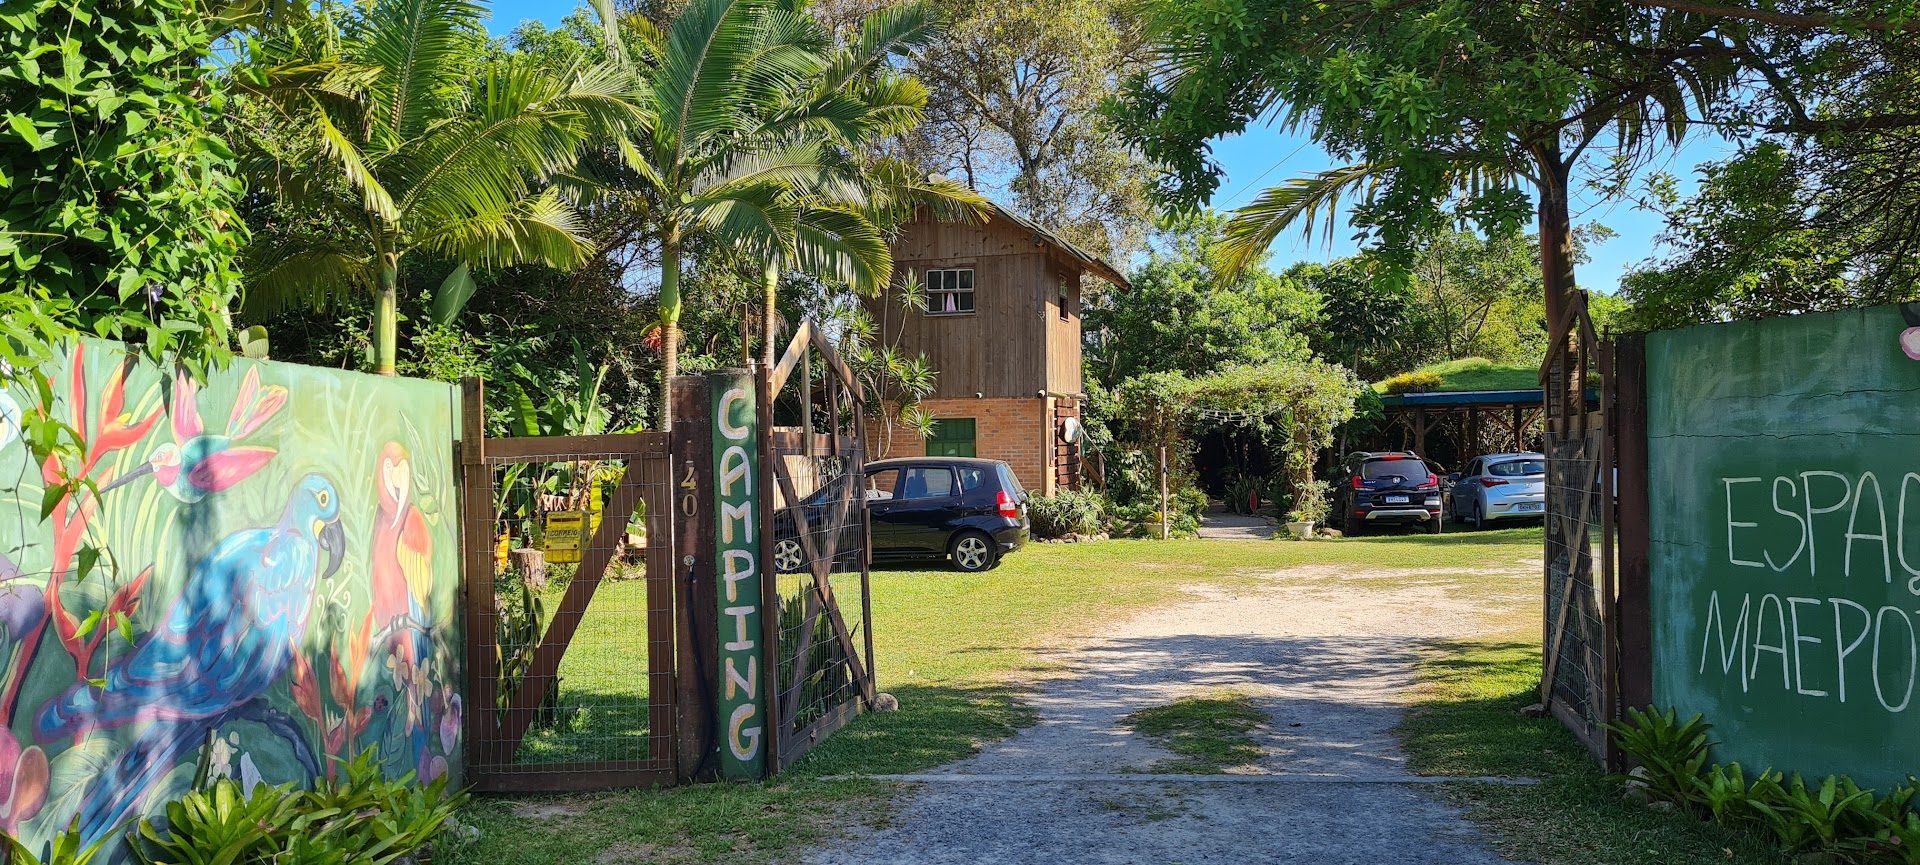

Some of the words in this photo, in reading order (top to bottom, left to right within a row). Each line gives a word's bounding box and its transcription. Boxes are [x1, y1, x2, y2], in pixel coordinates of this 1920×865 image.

[681, 467, 698, 517] 40
[718, 389, 762, 761] CAMPING
[1699, 590, 1920, 712] MAEPO
